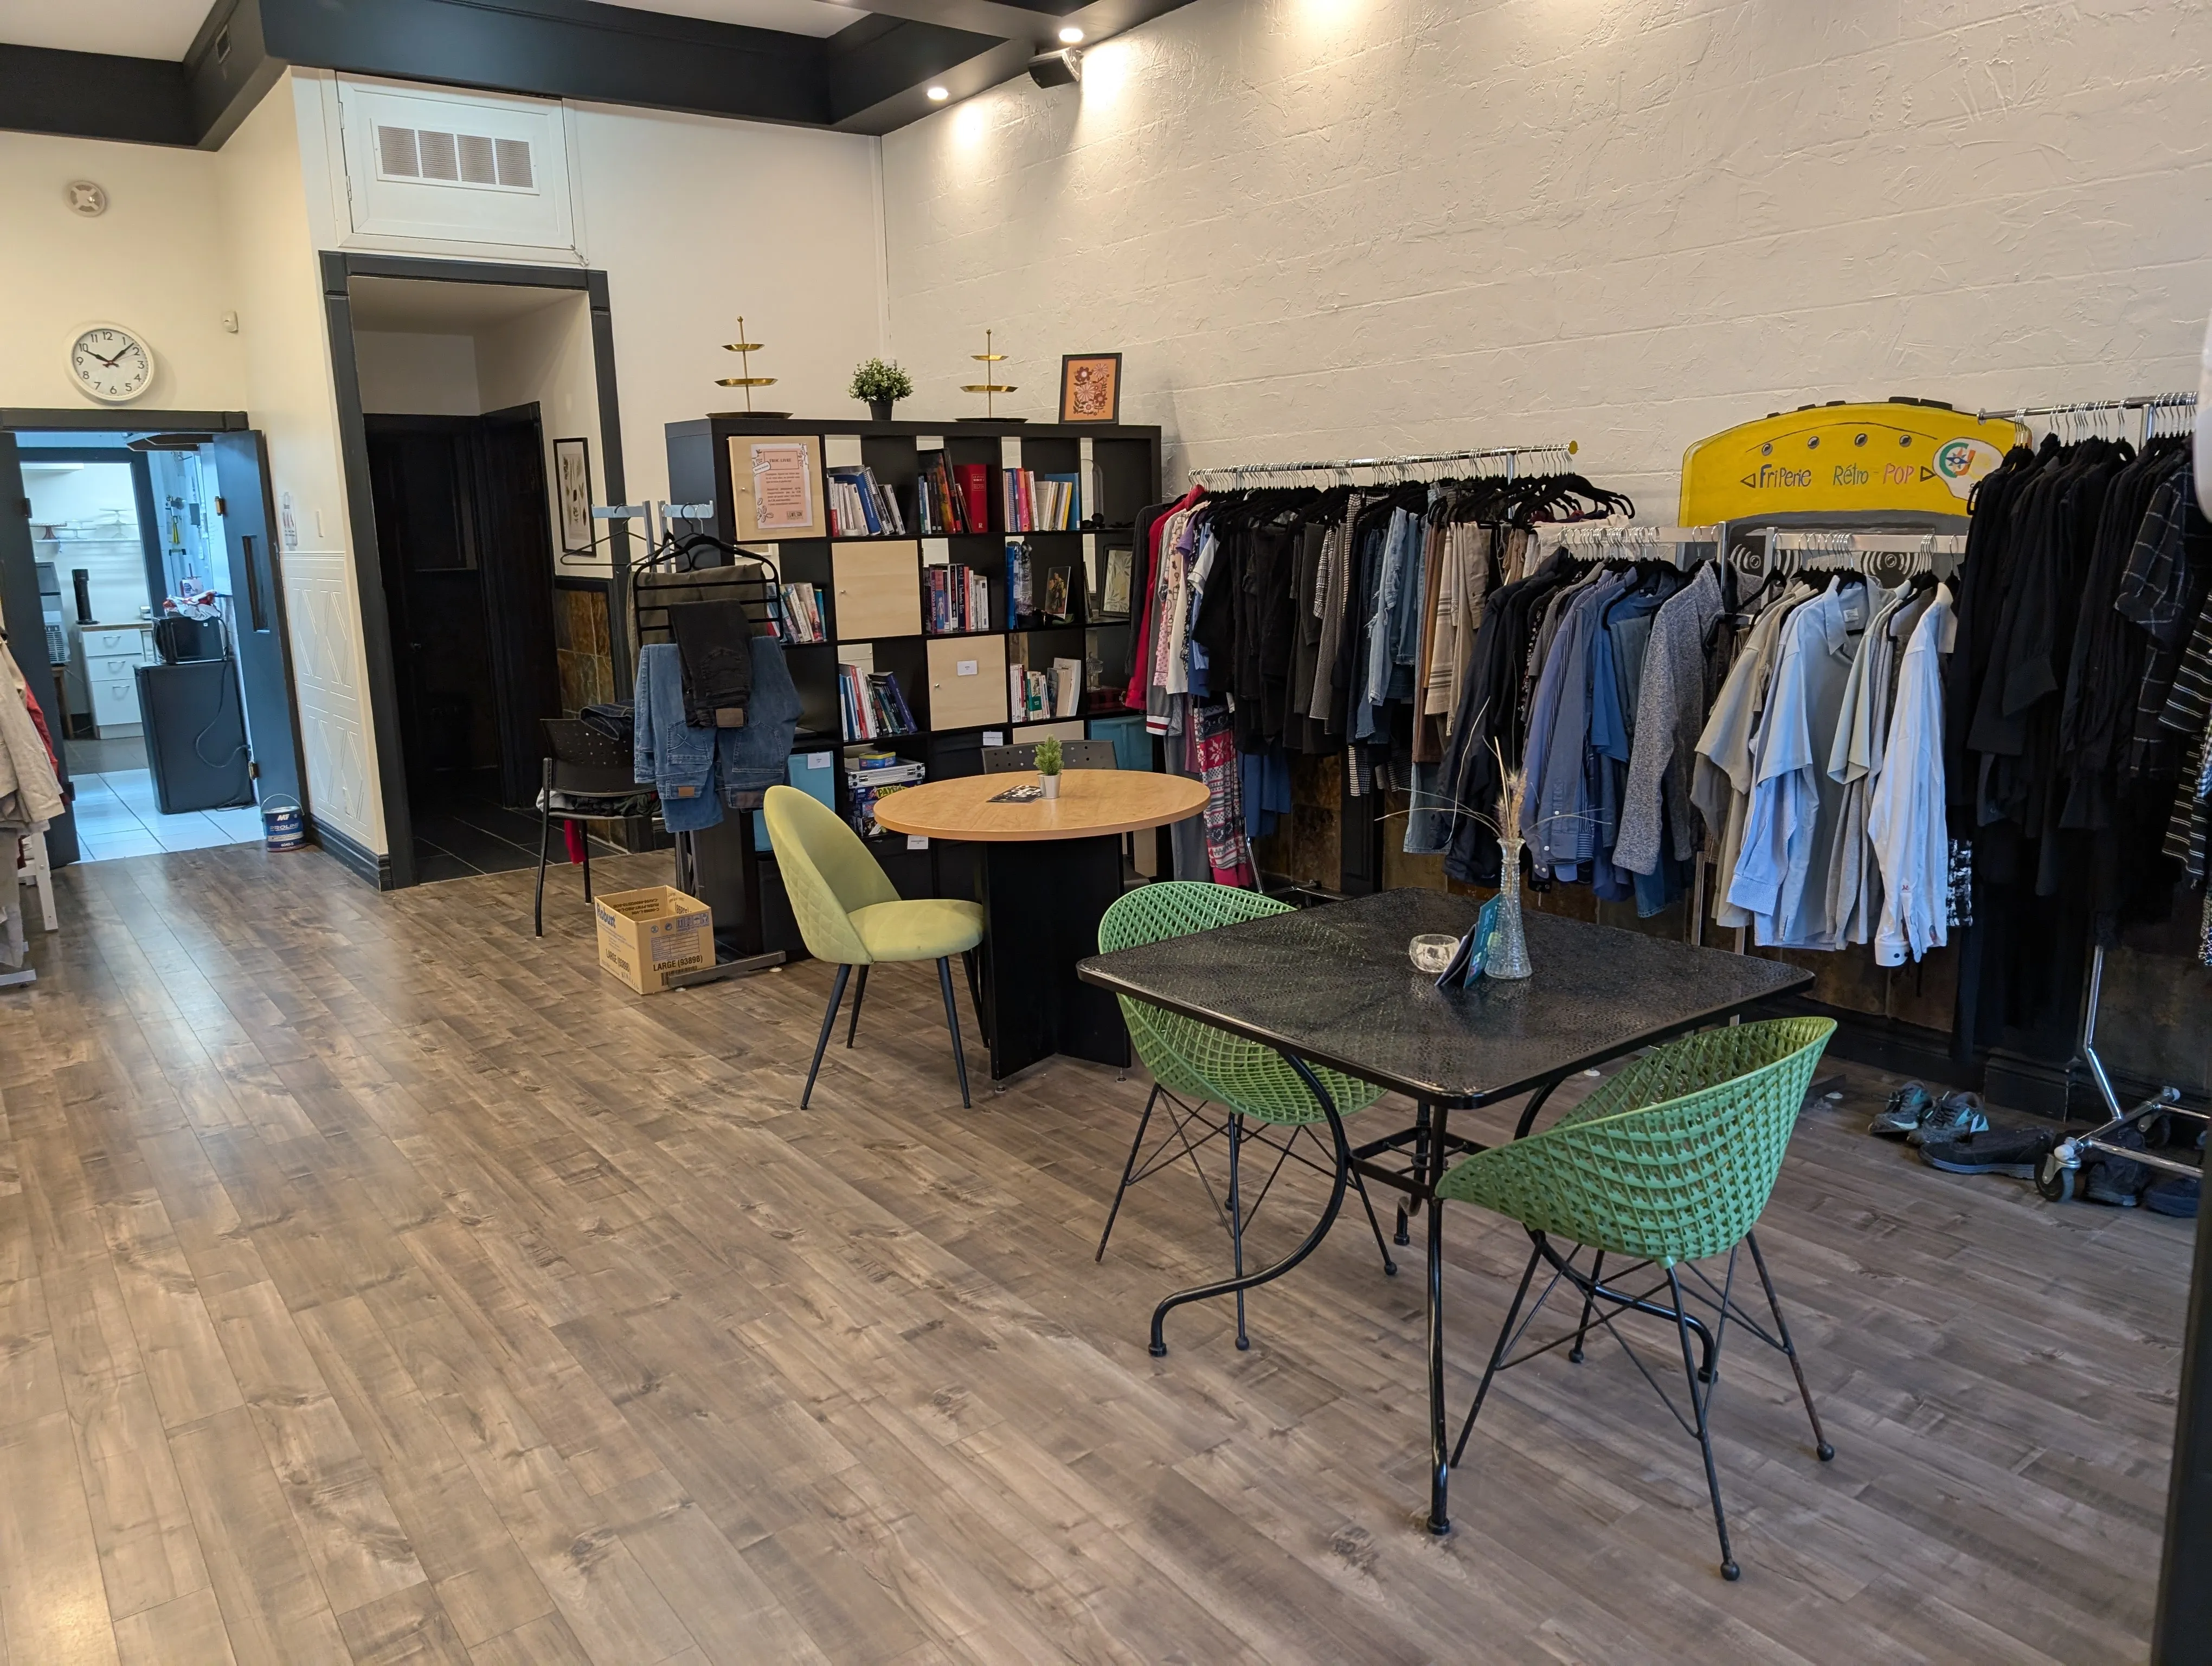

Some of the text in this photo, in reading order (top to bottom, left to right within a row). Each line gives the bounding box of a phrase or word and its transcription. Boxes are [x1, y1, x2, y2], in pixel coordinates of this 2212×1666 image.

[91, 334, 98, 343] 11
[102, 331, 113, 341] 12
[123, 337, 126, 345] 1
[79, 343, 88, 352] 10
[132, 347, 140, 356] 2
[76, 357, 84, 366] 9
[137, 361, 145, 369] 3
[82, 371, 89, 379] 8
[134, 374, 142, 382] 4
[94, 382, 101, 390] 7
[110, 386, 117, 394] 6
[125, 383, 132, 392] 5
[1833, 463, 1869, 485] Rétro
[1883, 463, 1914, 485] POP
[270, 822, 299, 830] PROLINE
[597, 902, 616, 928] Robust
[653, 954, 703, 971] LARGE (93898)
